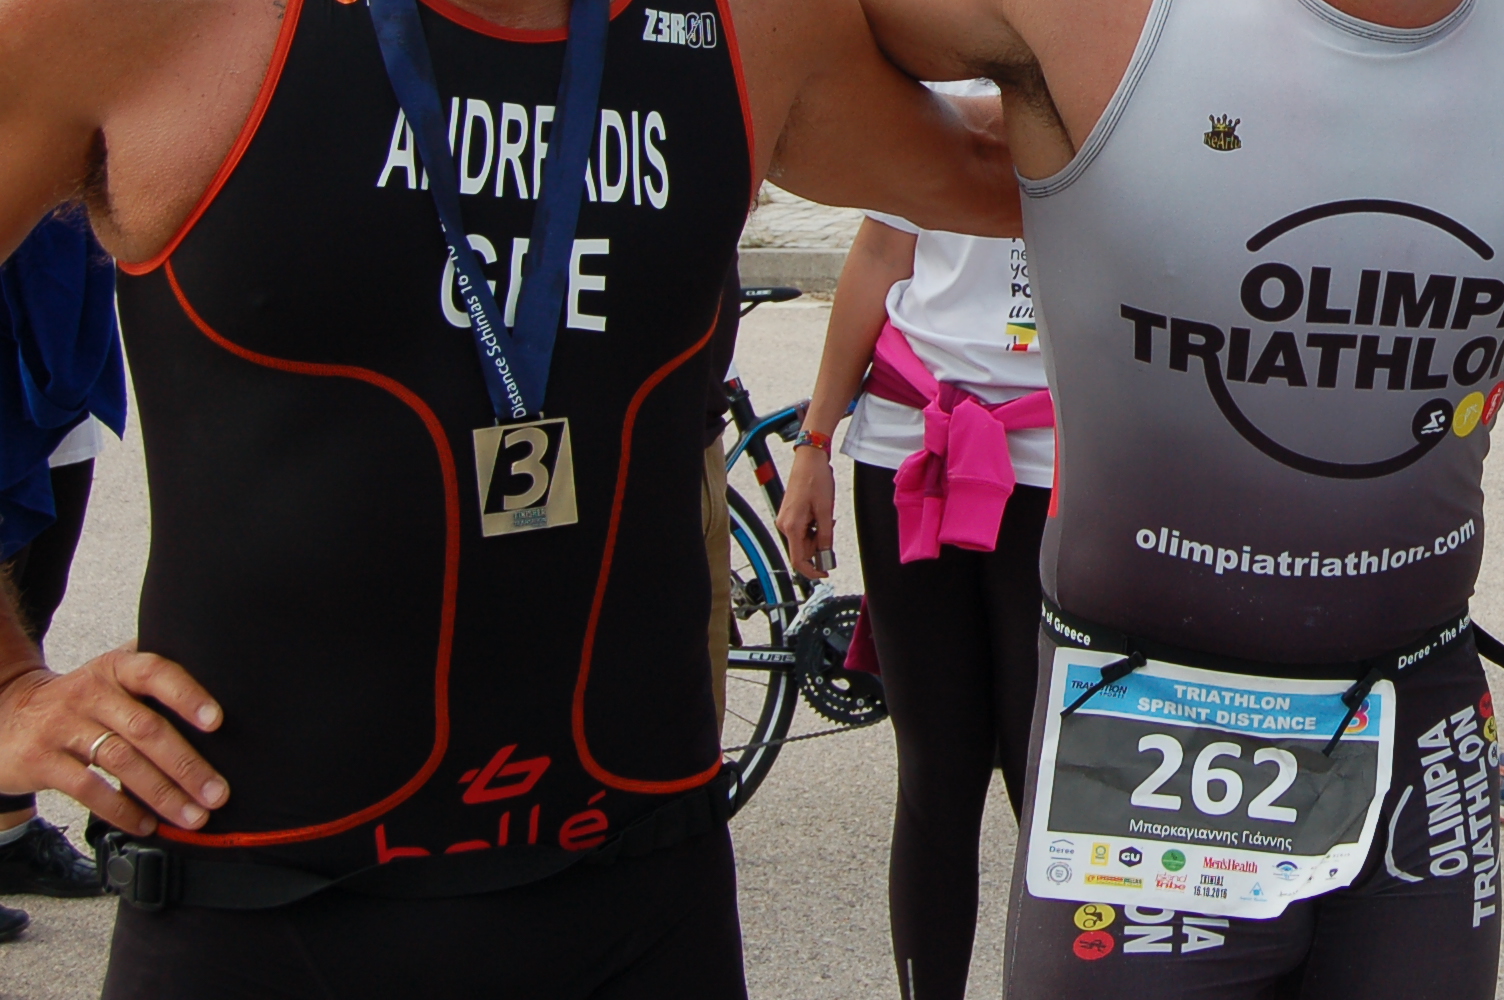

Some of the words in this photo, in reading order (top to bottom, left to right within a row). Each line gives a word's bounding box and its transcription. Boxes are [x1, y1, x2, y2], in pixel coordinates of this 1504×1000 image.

[467, 295, 501, 356] Schinias
[495, 356, 527, 419] Distance
[504, 427, 549, 511] 3
[1136, 518, 1475, 577] olimpiatriathlon.com
[1054, 617, 1091, 646] Greece
[1398, 645, 1430, 669] Deree
[1440, 628, 1457, 645] The
[1137, 697, 1210, 721] SPRINT
[1216, 711, 1316, 731] DISTANCE
[1174, 684, 1290, 710] TRIATHLON
[1130, 733, 1298, 823] 262
[1417, 718, 1468, 876] OLIMPIA
[1129, 819, 1239, 843] Μπαρκαγιαννης
[1242, 829, 1293, 851] Γιάννης
[1450, 705, 1496, 927] TRIATHLON
[1121, 852, 1141, 862] GU
